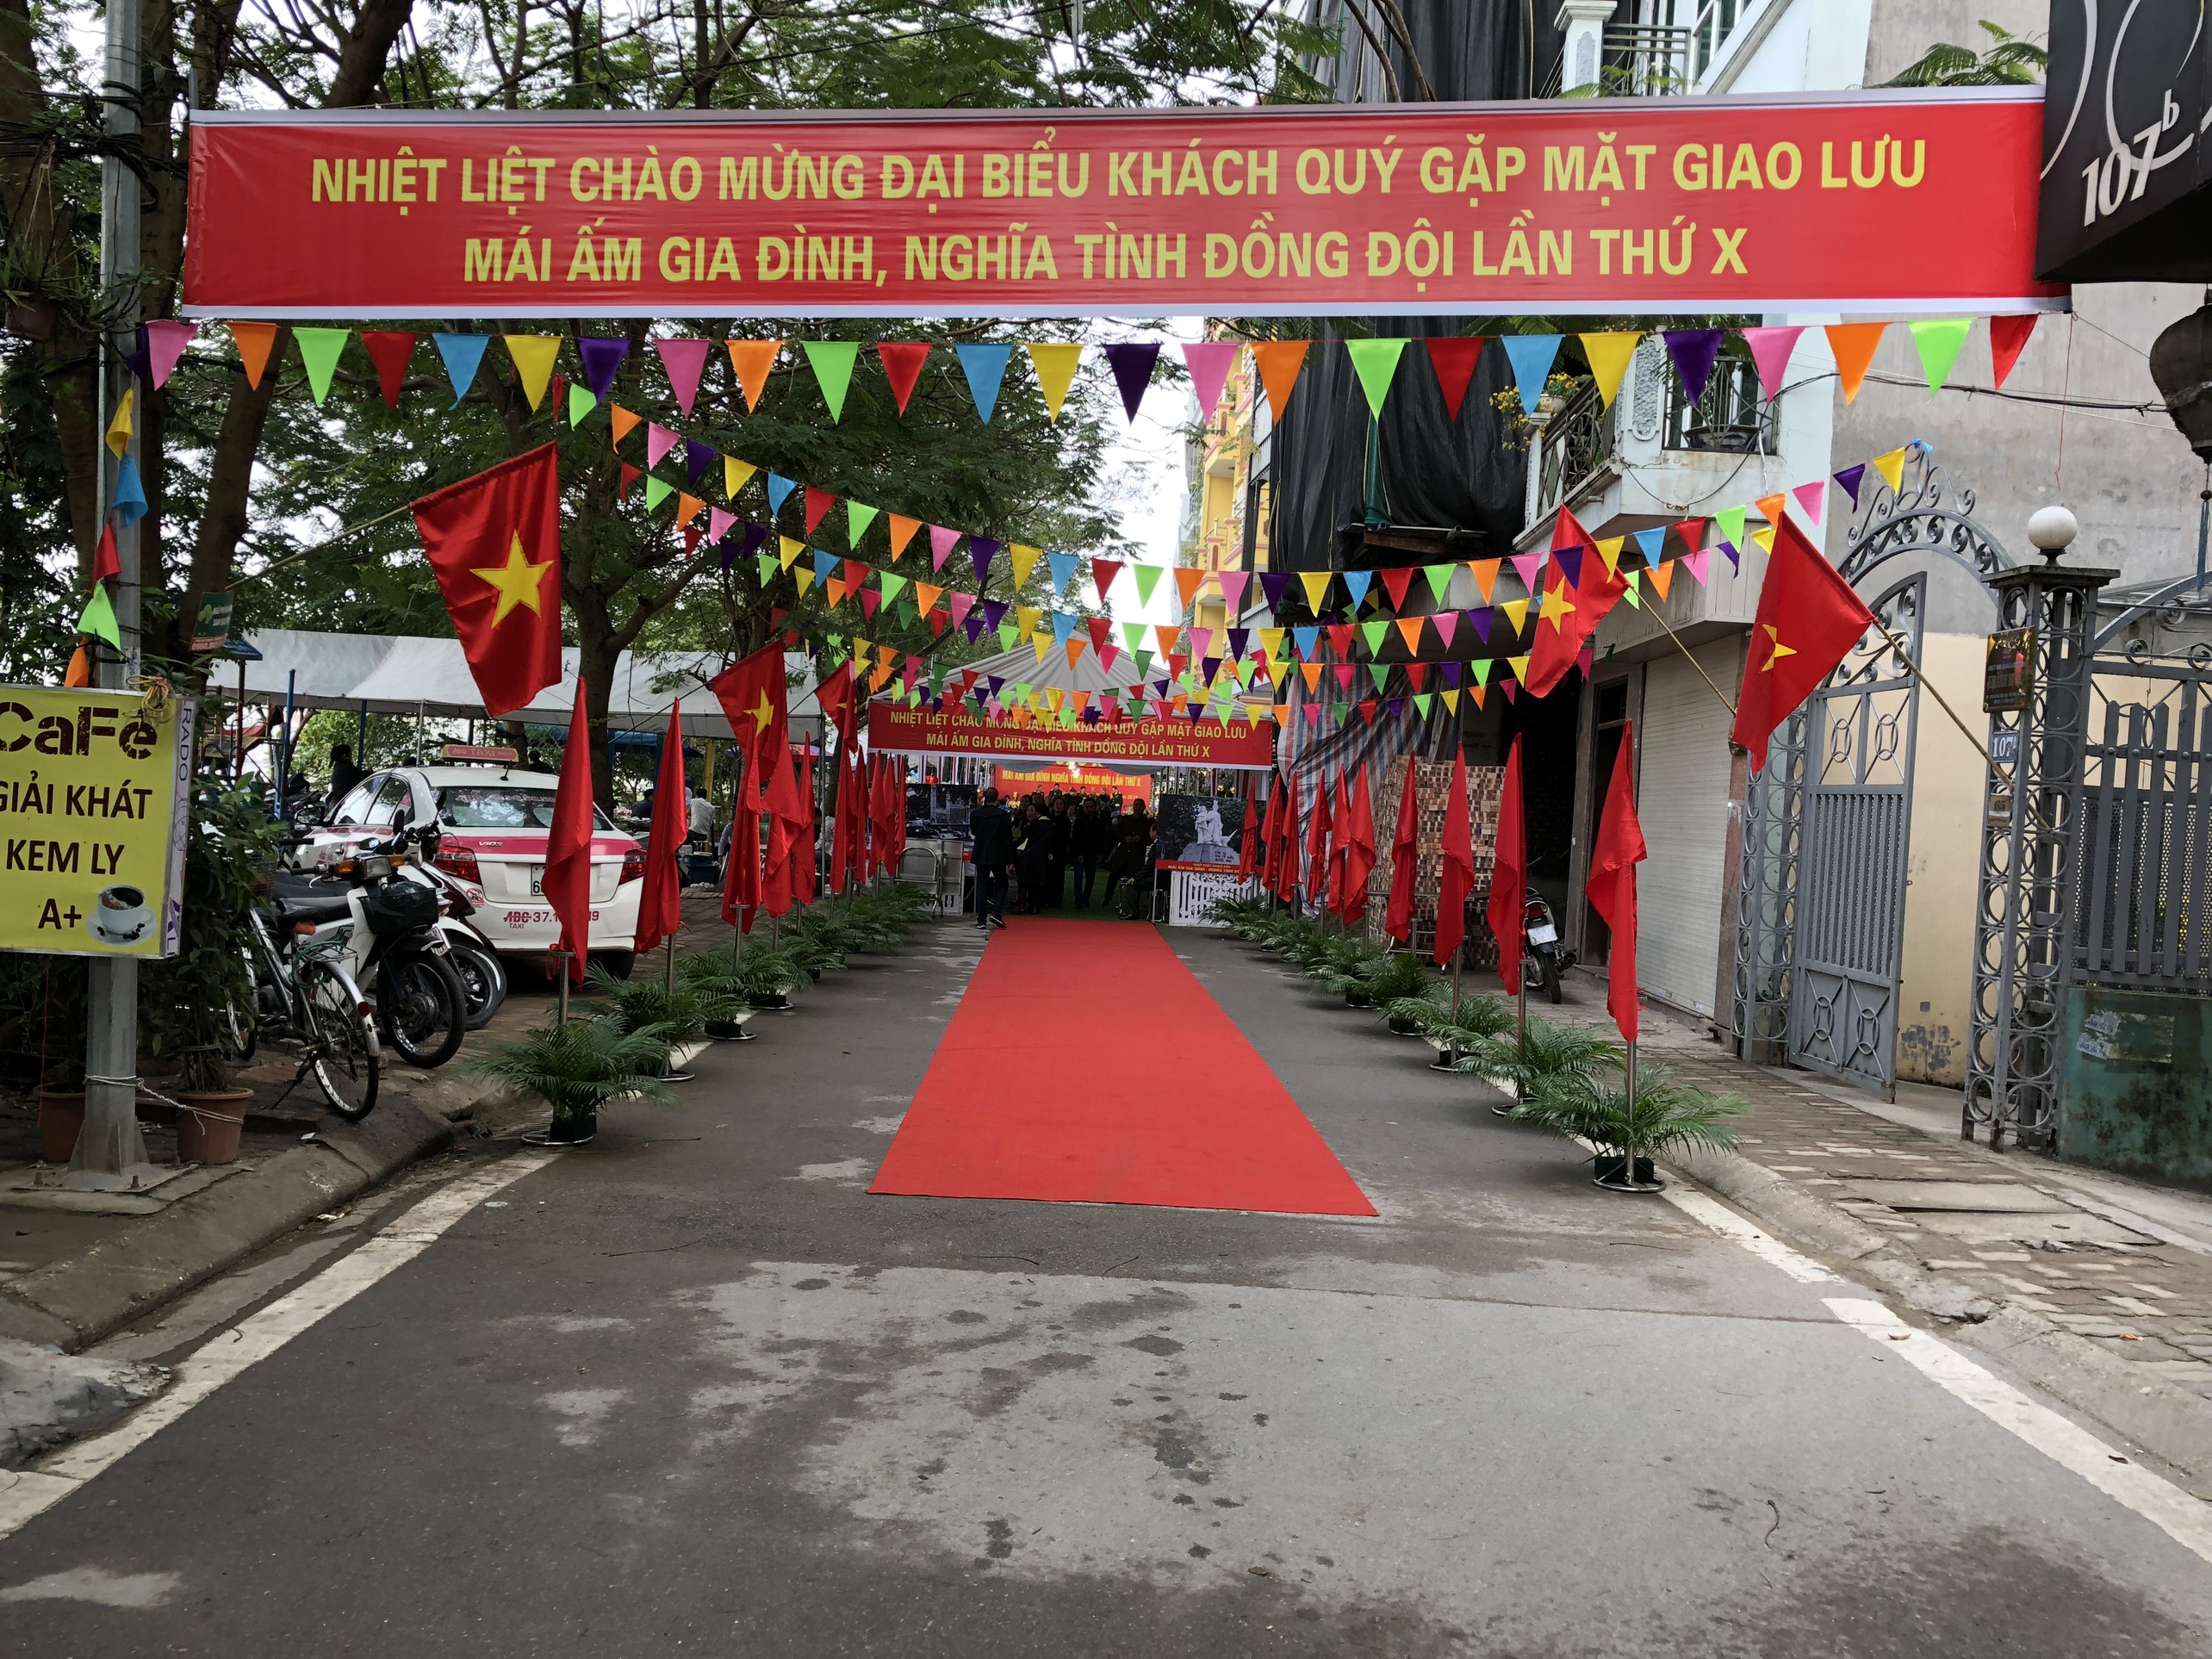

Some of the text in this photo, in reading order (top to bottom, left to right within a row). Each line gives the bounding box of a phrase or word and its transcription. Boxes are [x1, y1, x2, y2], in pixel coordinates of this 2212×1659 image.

[312, 127, 1926, 216] NHIỆT LIỆT CHÀO MỪNG ĐẠI BIỂU KHÁCH QUÝ GẶP MẶT GIAO LƯU
[464, 209, 1749, 292] MÁI ẤM GIA ĐÌNH, NGHĨA TÌNH ĐỒNG ĐỘI LẦN THỨ X
[179, 700, 193, 782] RADO
[891, 710, 923, 728] NHIỆT
[926, 711, 949, 729] LIỆT
[1141, 721, 1165, 739] GẶP
[1167, 722, 1192, 740] MẶT
[1195, 725, 1222, 738] GIAO
[1225, 724, 1246, 739] LƯU
[469, 748, 495, 757] TAXI
[926, 730, 1210, 758] MÁI ẤM GIA ĐÌNH, NGHĨA TÌNH ĐỒNG ĐỘI LẦN THỨ X
[65, 779, 153, 820] KHÁT
[6, 839, 125, 875] KEM LY
[38, 898, 83, 930] A+
[503, 910, 531, 923] ABC
